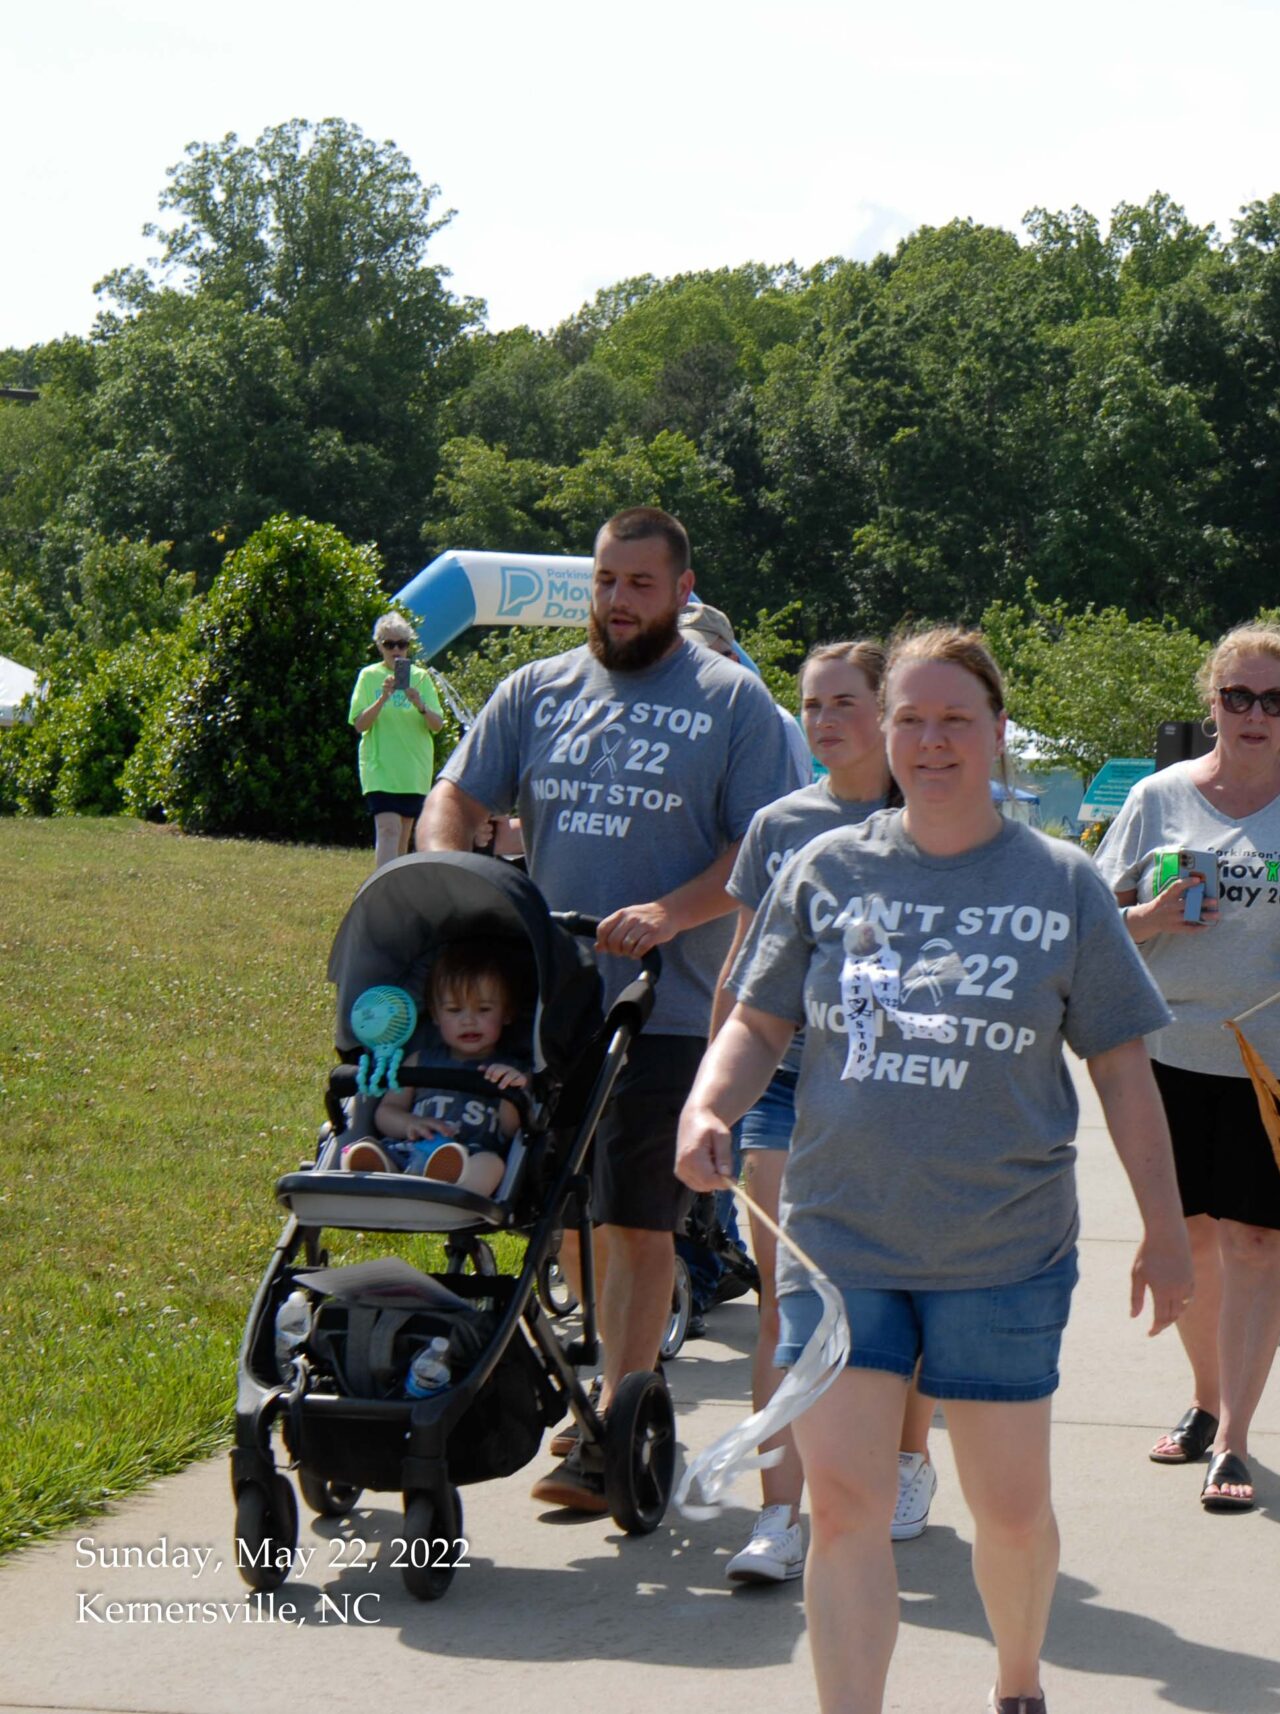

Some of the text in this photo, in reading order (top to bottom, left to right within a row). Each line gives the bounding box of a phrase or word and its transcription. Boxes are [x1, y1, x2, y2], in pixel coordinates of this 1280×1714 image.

[543, 602, 590, 622] Day
[534, 696, 713, 741] CANT STOP
[549, 734, 671, 775] 20 22
[531, 778, 683, 813] WON'T STOP
[557, 809, 631, 838] CREW
[809, 891, 1071, 952] CAN'T STOP
[955, 953, 1018, 1000] 22
[936, 1015, 1036, 1054] STOP
[872, 1051, 969, 1090] REW
